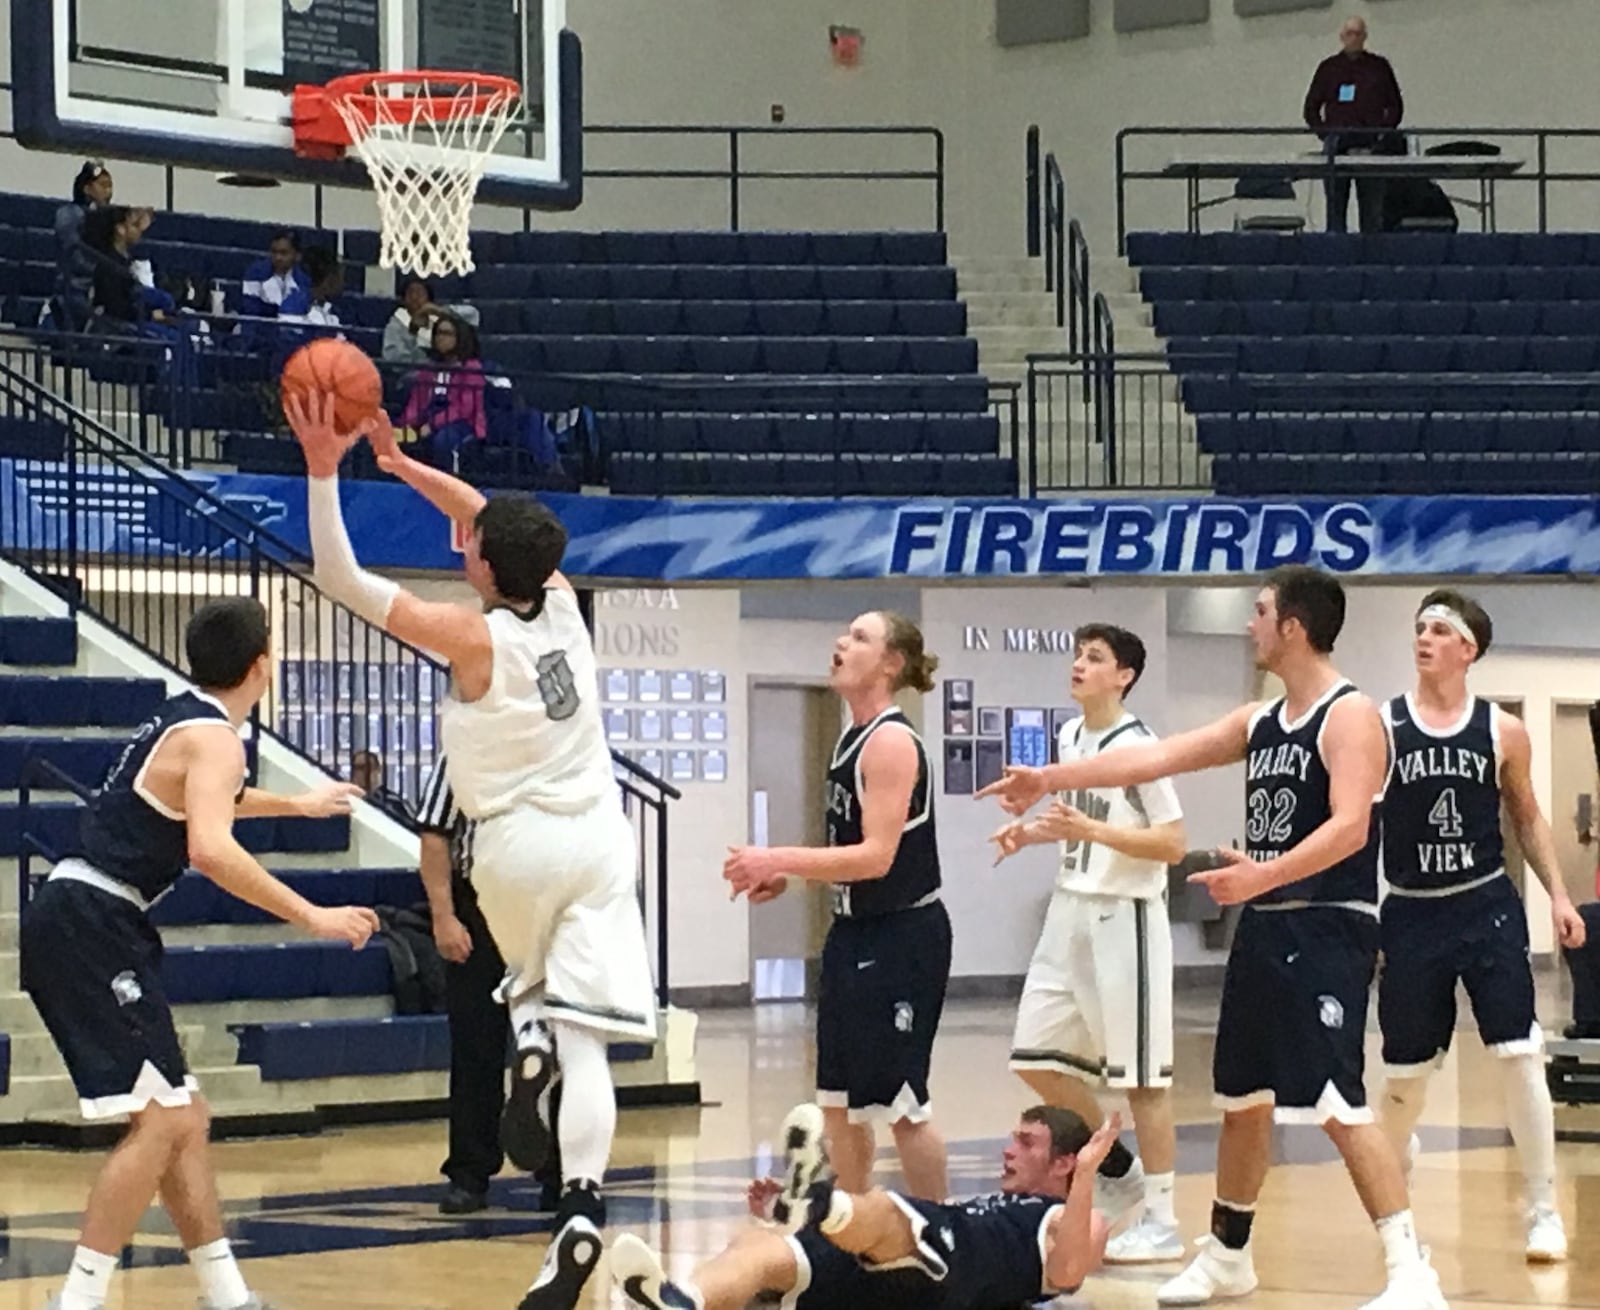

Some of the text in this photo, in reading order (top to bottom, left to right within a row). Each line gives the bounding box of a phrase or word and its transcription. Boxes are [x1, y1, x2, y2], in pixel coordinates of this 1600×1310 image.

[889, 502, 1372, 574] FIREBIRDS
[1397, 746, 1489, 784] VALLEY
[1247, 787, 1297, 842] 32
[1428, 787, 1463, 837] 4
[1417, 842, 1476, 873] VIEW
